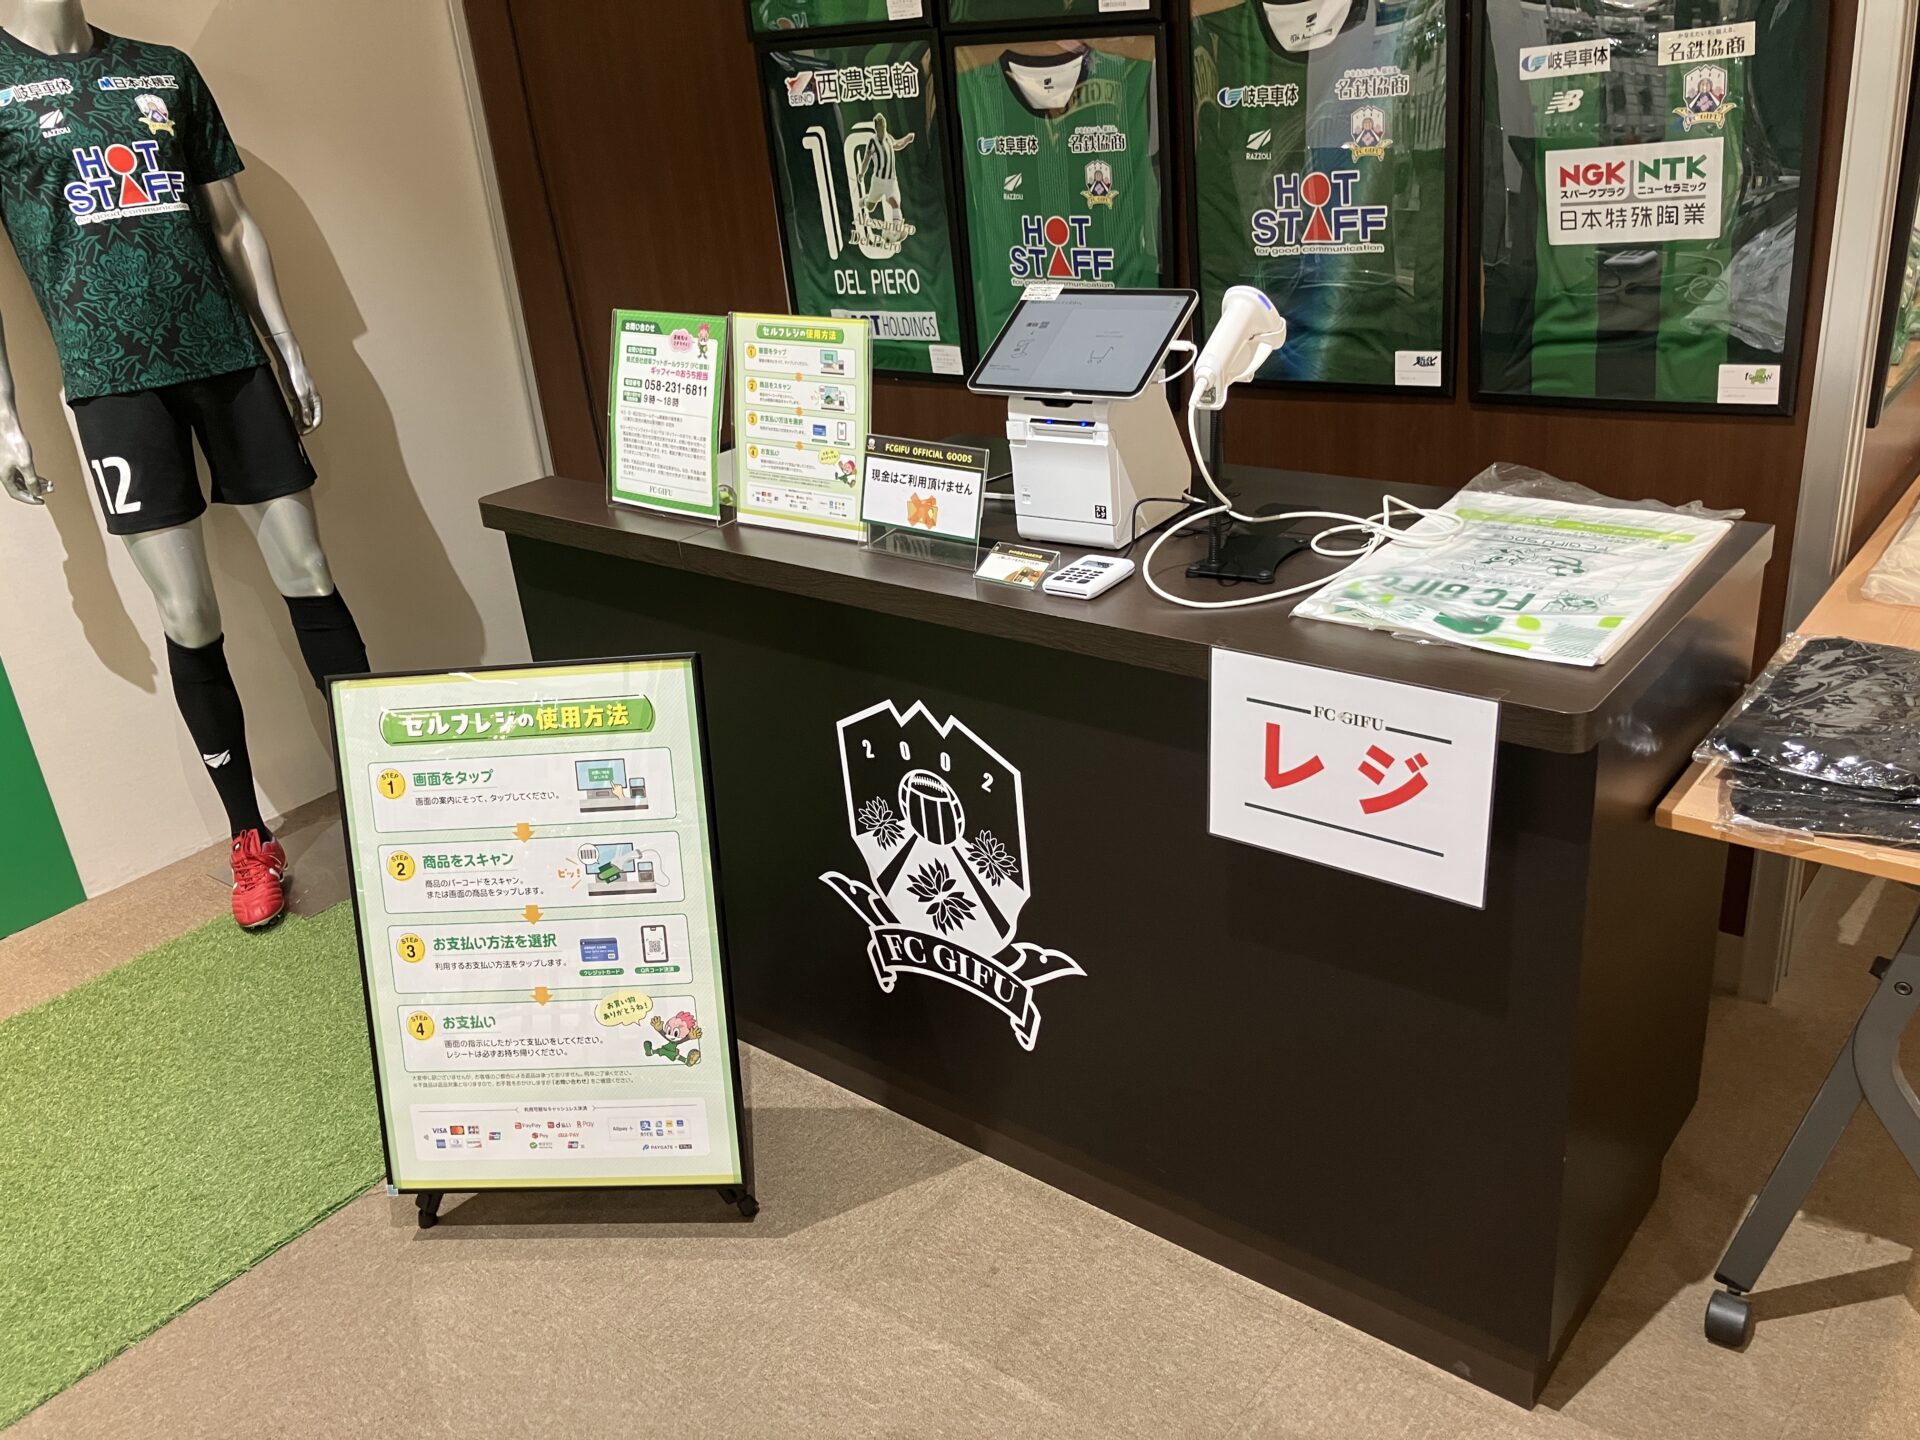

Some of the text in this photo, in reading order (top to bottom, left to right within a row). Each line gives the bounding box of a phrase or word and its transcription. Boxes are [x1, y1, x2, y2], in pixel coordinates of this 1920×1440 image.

[1669, 36, 1745, 61] 名鉄協商
[1547, 47, 1608, 70] 岐阜車体
[14, 80, 72, 101] 岐阜車体
[815, 63, 917, 102] 西濃運輸
[1337, 76, 1409, 98] 名鉄協商
[790, 95, 813, 104] SEINO
[1243, 84, 1298, 106] 岐阜車体
[995, 136, 1038, 154] 岐阜車体
[1069, 132, 1126, 152] 名鉄協商
[1246, 152, 1272, 160] RAZZOLI
[1560, 154, 1707, 188] NGK NTK
[1560, 182, 1707, 200] スパークプラグ ニューセラミック
[1560, 202, 1706, 231] 日本特殊陶業
[1272, 246, 1299, 256] good
[1303, 244, 1384, 253] communication
[834, 269, 920, 295] DEL PIERO
[625, 322, 656, 333] お問い合わせ
[762, 326, 837, 340] セルフレジの使用方法
[882, 316, 937, 337] HOLDINGS
[644, 378, 707, 397] 058-231-6811
[885, 443, 973, 464] FCGIFU OFFICIAL GOODS
[91, 456, 142, 515] 12
[649, 485, 673, 497] FC GIFU
[871, 468, 973, 496] 現金はご利用頂けません
[1472, 588, 1537, 612] FC
[402, 703, 630, 738] セルフレジの使用方法
[1313, 705, 1385, 731] FC GIFU
[381, 772, 399, 781] STEP
[1264, 721, 1430, 815] レジ
[412, 768, 495, 787] 画面をタップ
[387, 780, 394, 795] 1
[415, 792, 560, 806] 画面の案内にそって、タップしてください。
[391, 854, 409, 863] STEP
[422, 852, 515, 870] 商品をスキャン
[396, 862, 407, 876] 2
[425, 877, 524, 889] 商品のバーコードをスキャン。
[426, 887, 545, 899] または画面の商品をタップします。
[400, 936, 419, 945] STEP
[432, 932, 557, 952] お支払い方法を選択
[406, 944, 416, 959] 3
[434, 958, 567, 971] 利用するお支払い方法をタップします。
[882, 933, 1019, 1003] FC GIFU
[410, 1014, 429, 1023] STEP
[442, 1014, 497, 1030] お支払い
[415, 1022, 425, 1036] 4
